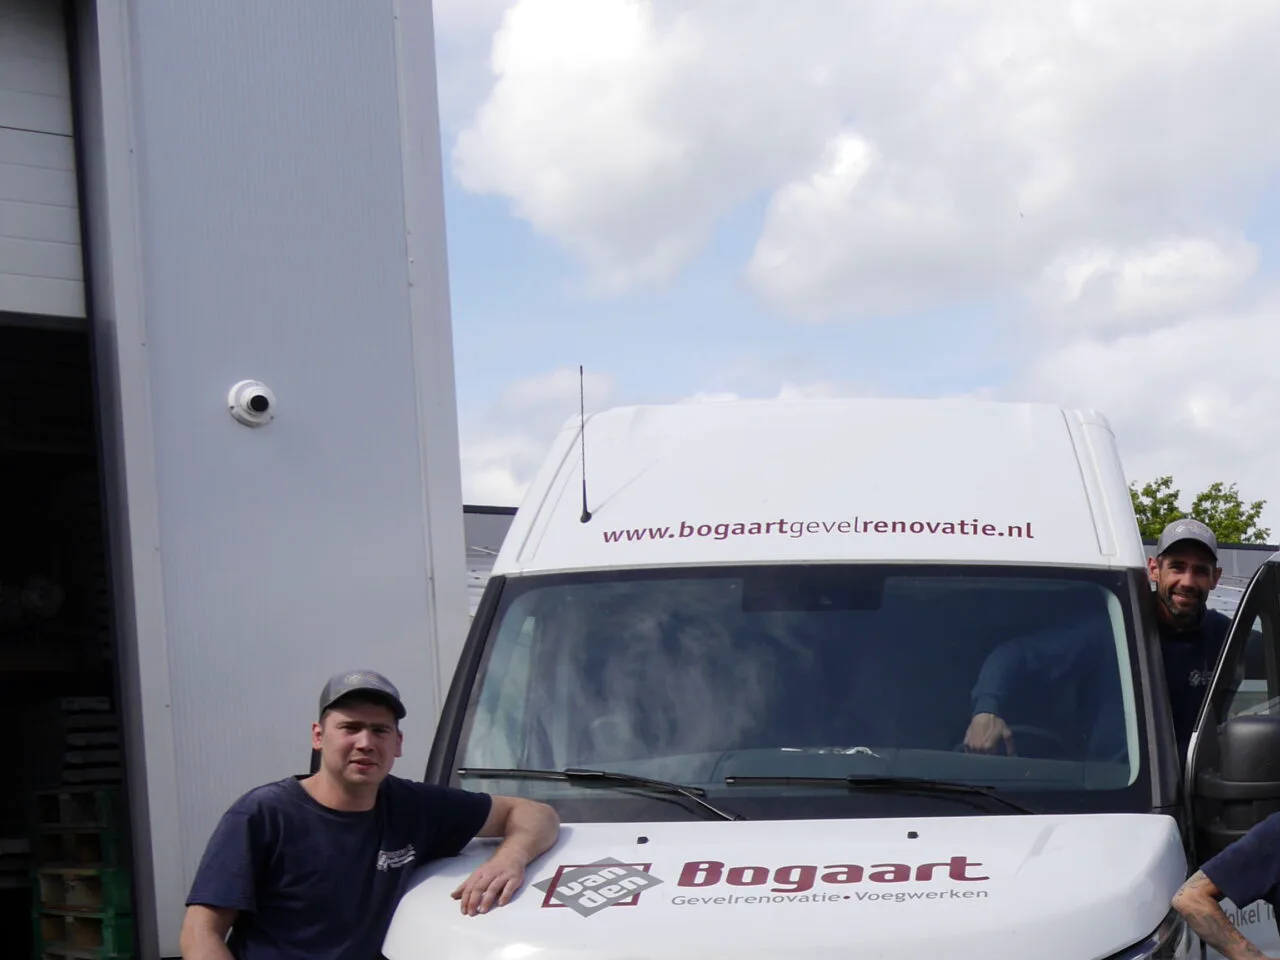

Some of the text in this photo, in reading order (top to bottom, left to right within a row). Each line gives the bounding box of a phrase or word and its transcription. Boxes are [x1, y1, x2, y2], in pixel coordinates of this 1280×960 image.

[603, 516, 1035, 543] www.bogaartgevelrenovatie.nl
[556, 867, 628, 896] van
[677, 856, 990, 893] Bogaart
[578, 877, 649, 907] den
[671, 888, 988, 906] Gevelrenovatie Voegwerken
[1224, 902, 1260, 927] olkel
